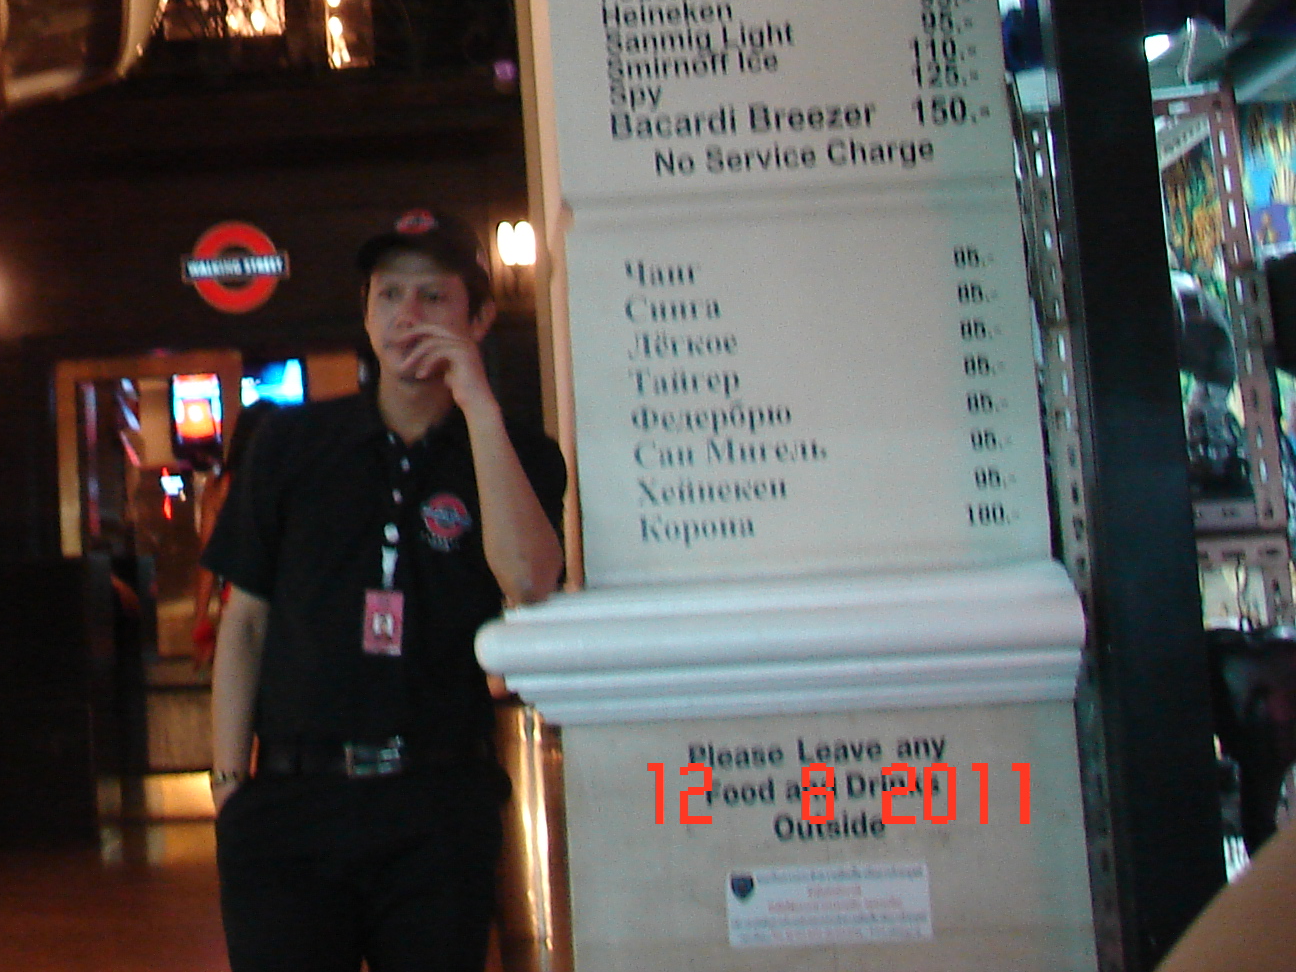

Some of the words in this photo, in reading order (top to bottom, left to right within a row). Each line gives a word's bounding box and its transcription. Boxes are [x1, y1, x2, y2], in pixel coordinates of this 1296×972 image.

[603, 0, 733, 29] Heineken
[722, 18, 795, 52] Light
[608, 49, 728, 81] Smirnoff
[738, 48, 779, 75] Ice
[610, 80, 663, 113] Spy
[611, 105, 737, 142] Bacardi
[748, 100, 876, 134] Breezer
[655, 147, 695, 177] No
[705, 141, 816, 173] Service
[826, 135, 935, 169] Charge
[688, 739, 784, 770] Please
[796, 735, 883, 765] Leave
[896, 734, 946, 763] any
[705, 773, 775, 807] Food
[772, 809, 886, 842] Outside
